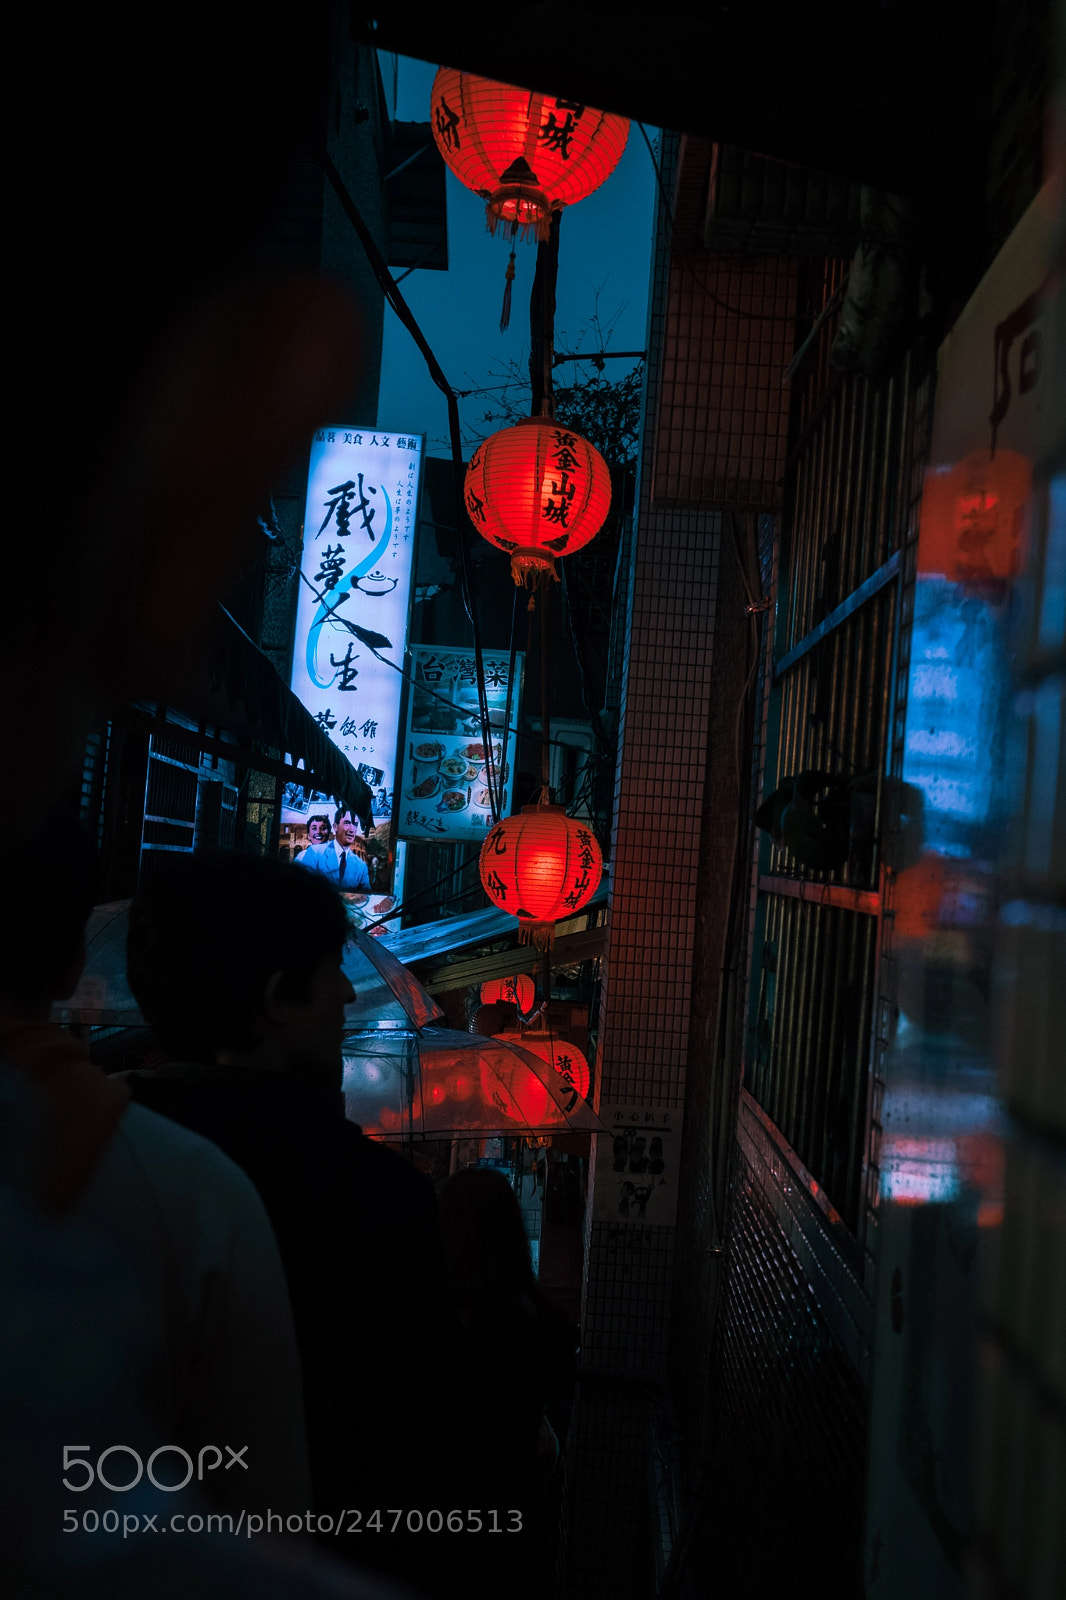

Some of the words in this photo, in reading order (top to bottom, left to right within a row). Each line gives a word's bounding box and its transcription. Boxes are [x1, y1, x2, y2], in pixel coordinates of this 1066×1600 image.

[343, 433, 363, 445] 美食
[369, 435, 390, 447] 人文
[421, 655, 509, 687] 台灣菜
